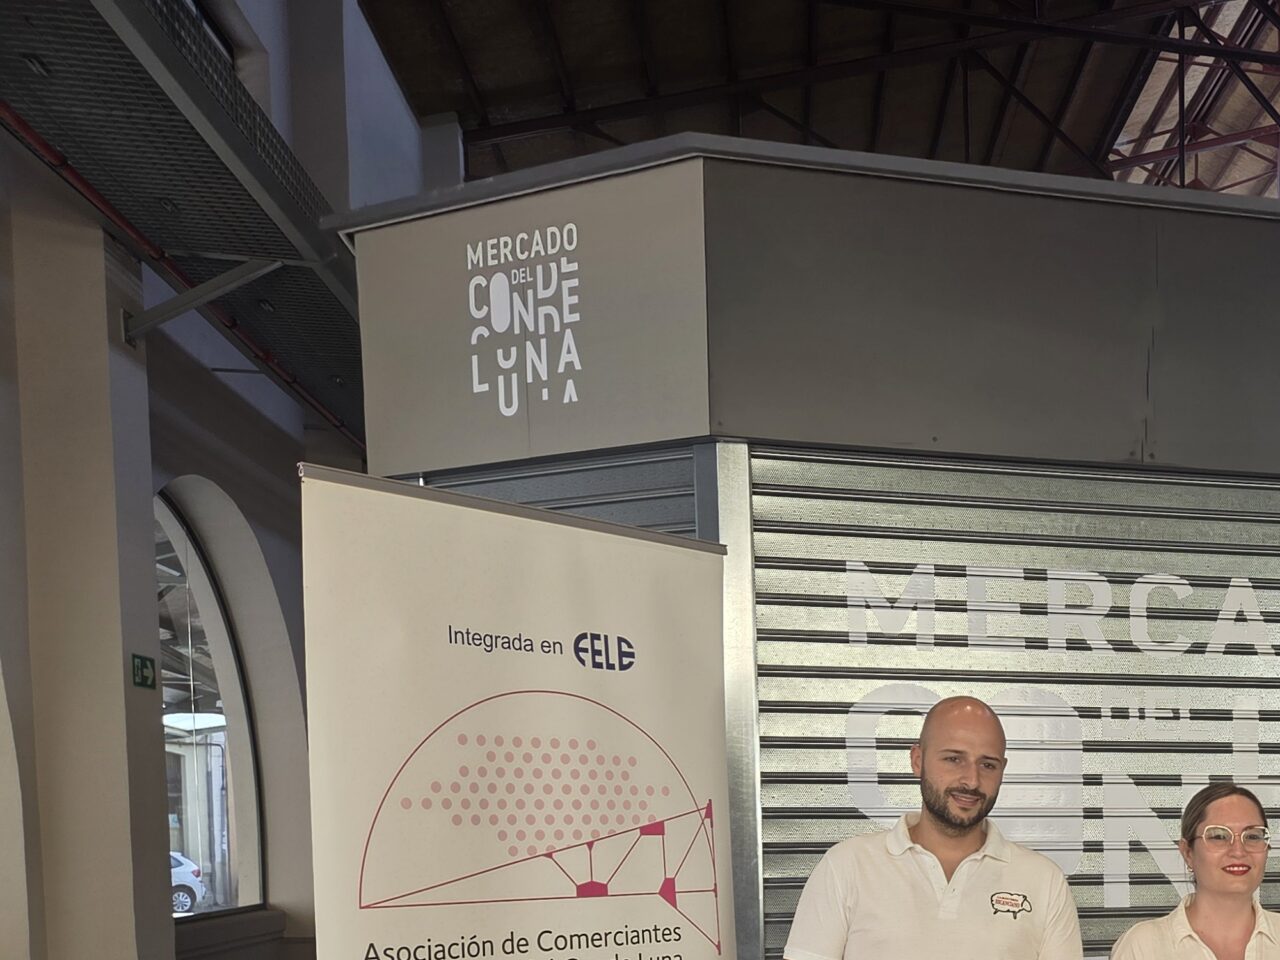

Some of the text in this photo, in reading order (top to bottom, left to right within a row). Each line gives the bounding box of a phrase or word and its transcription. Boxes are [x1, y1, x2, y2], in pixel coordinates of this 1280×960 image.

[467, 223, 578, 270] MERCADO
[511, 268, 533, 284] DEL
[448, 625, 534, 653] Integrada
[540, 638, 563, 655] en
[501, 931, 529, 956] de
[536, 917, 682, 952] Comerciantes
